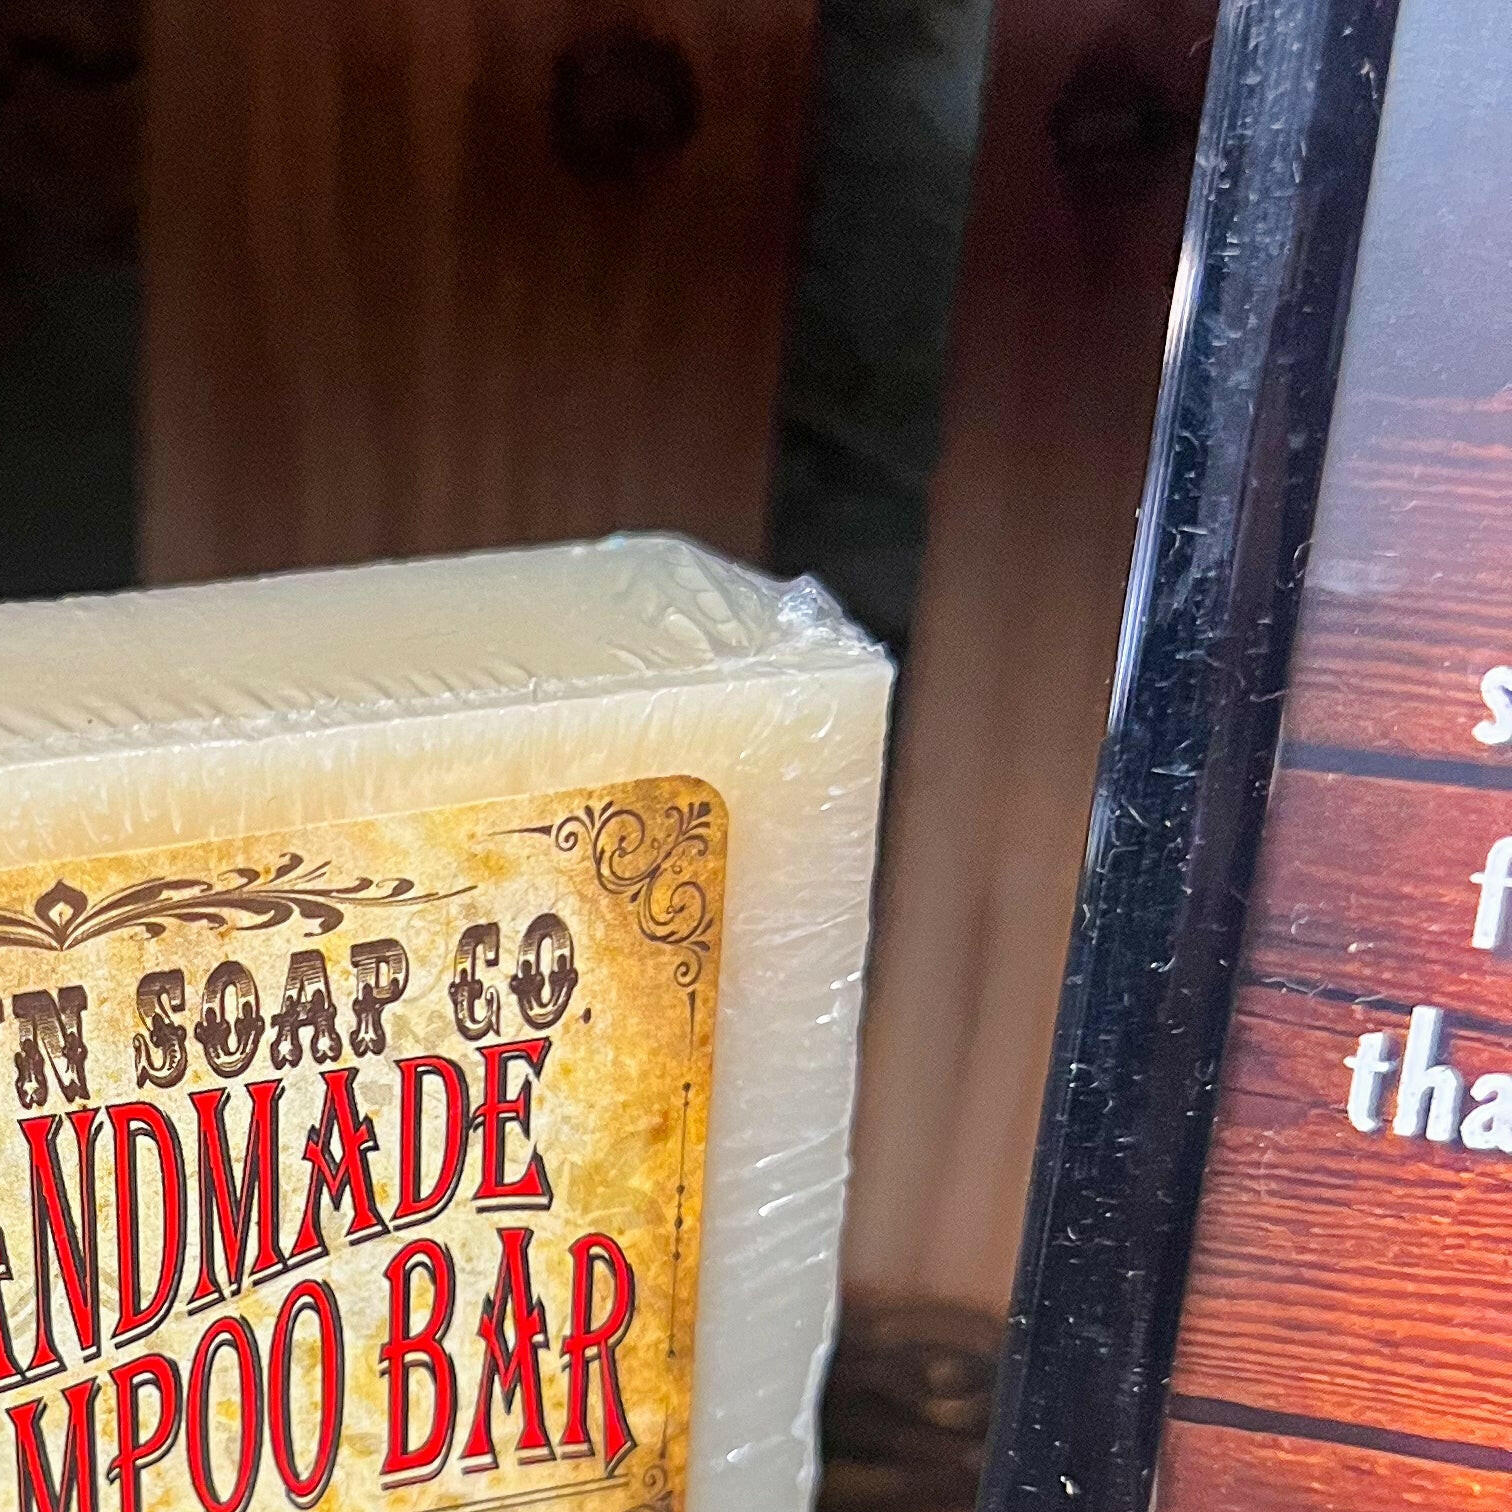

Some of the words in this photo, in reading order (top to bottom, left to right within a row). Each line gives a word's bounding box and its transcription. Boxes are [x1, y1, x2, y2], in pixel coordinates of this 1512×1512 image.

[135, 937, 410, 1089] SOAP
[449, 912, 592, 1042] CO.
[377, 1227, 636, 1490] BAR
